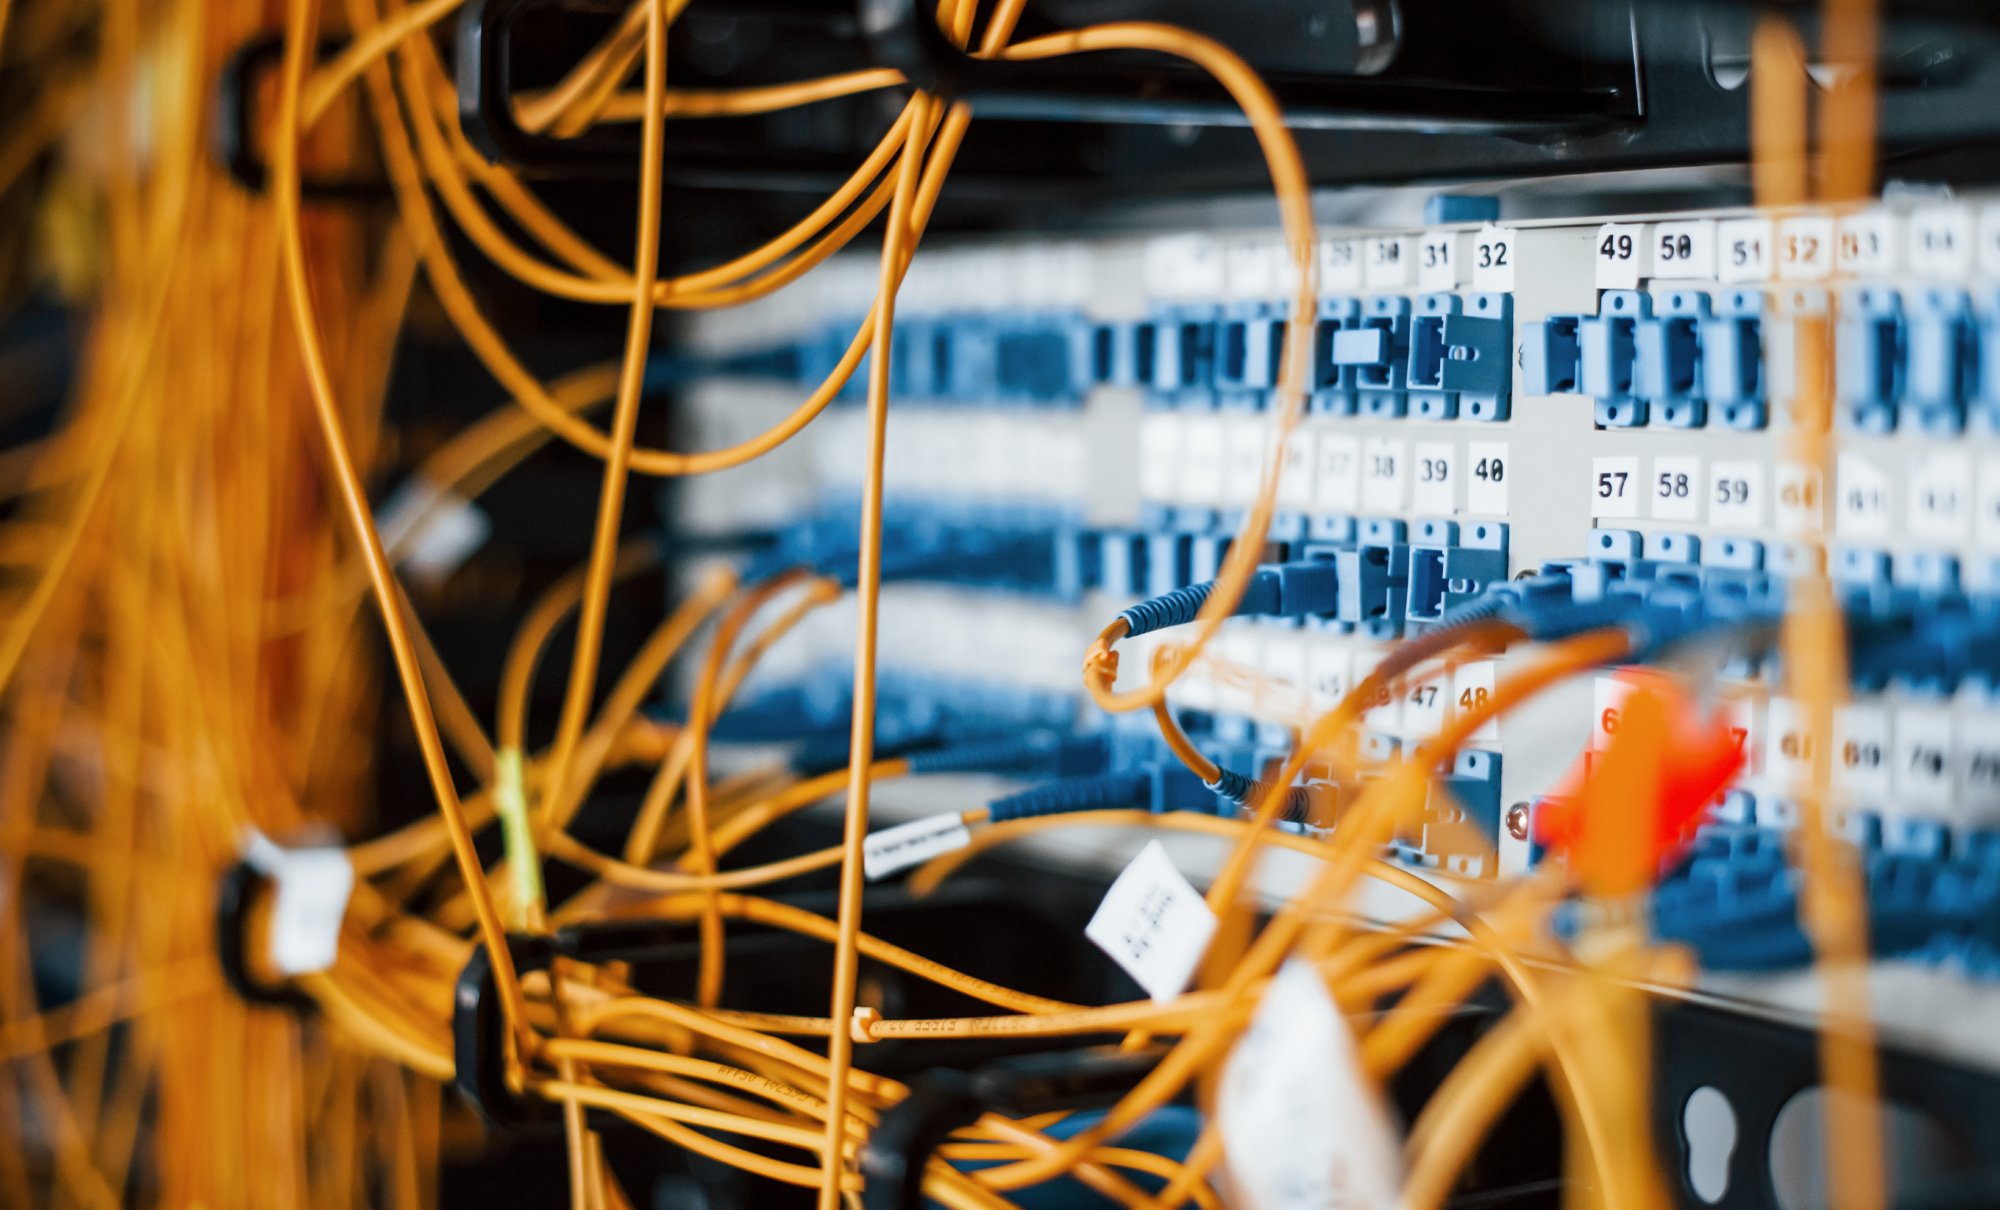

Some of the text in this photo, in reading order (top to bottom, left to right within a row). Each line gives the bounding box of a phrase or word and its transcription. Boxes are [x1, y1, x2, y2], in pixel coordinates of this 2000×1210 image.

[1425, 241, 1448, 268] 31
[1478, 242, 1507, 268] 32
[1600, 234, 1632, 260] 49
[1660, 233, 1692, 260] 50
[1732, 239, 1761, 266] 51
[1421, 458, 1448, 482] 39
[1475, 457, 1504, 482] 40
[1598, 472, 1628, 498] 57
[1659, 472, 1689, 498] 58
[1717, 479, 1749, 504] 59
[1410, 686, 1438, 708] 47
[1459, 687, 1488, 711] 48
